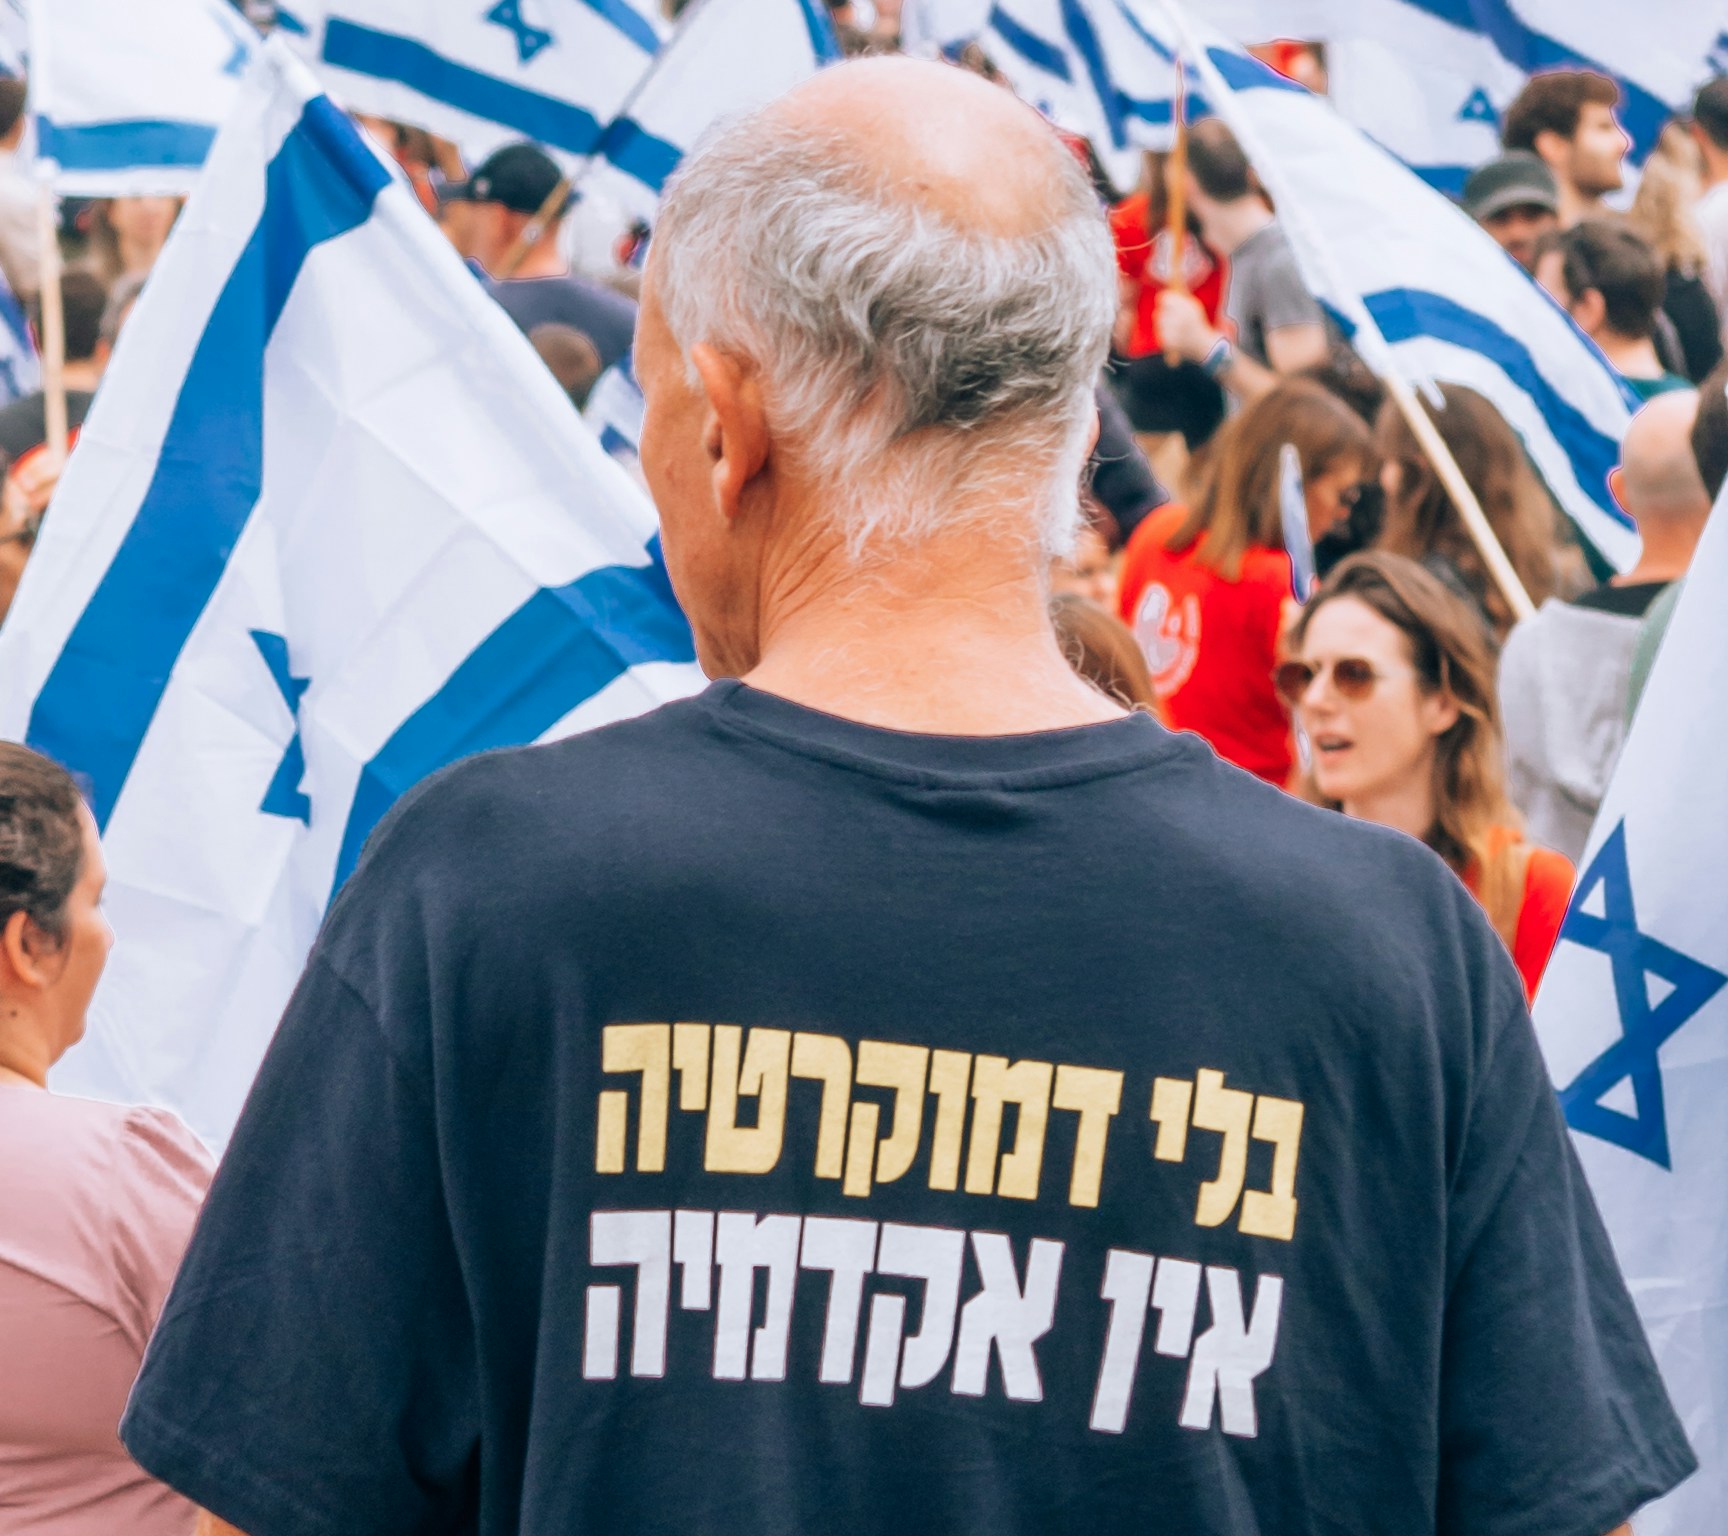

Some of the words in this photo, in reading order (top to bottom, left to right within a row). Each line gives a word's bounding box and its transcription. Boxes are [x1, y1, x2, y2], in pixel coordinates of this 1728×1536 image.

[595, 1022, 1125, 1208] דמוקרטיה
[1149, 1067, 1304, 1241] בלי
[582, 1208, 1067, 1408] אקדמיה
[1088, 1248, 1285, 1439] אין
